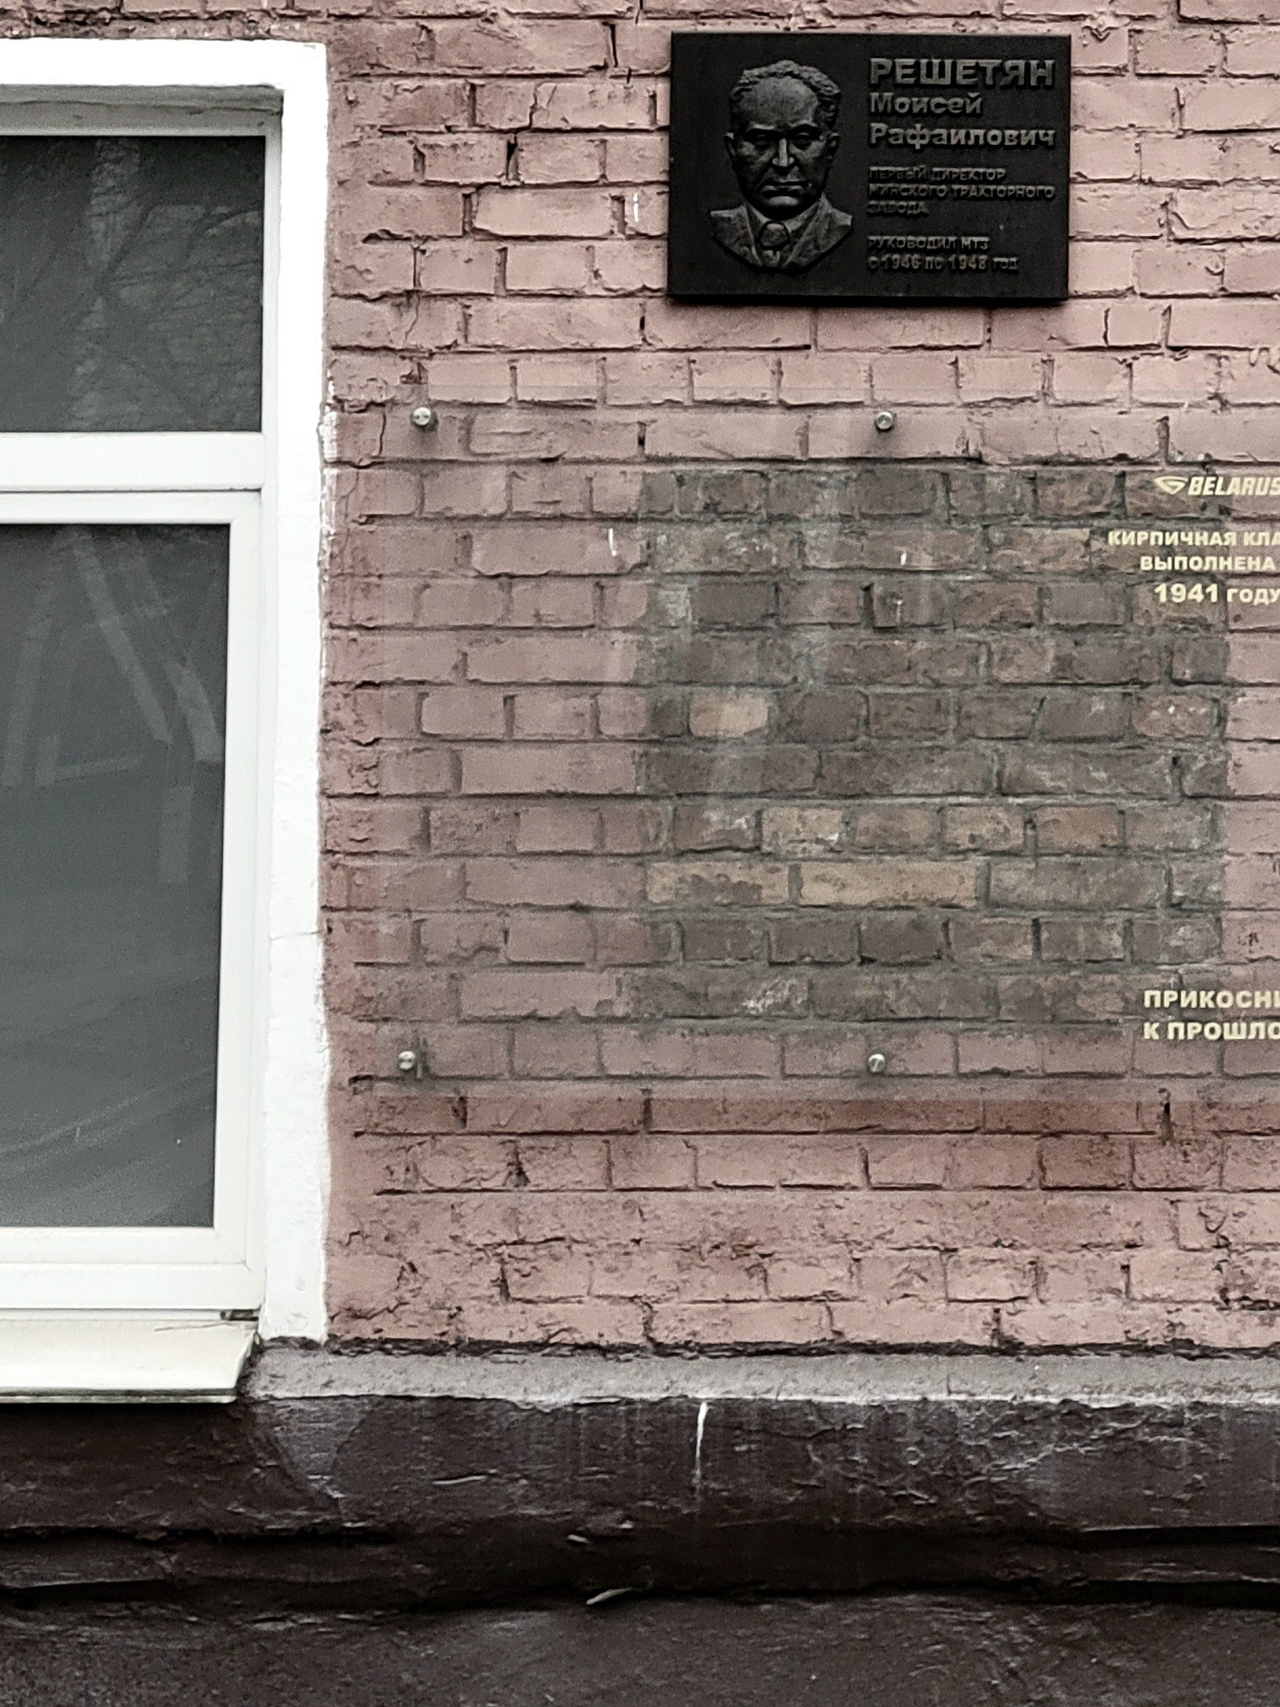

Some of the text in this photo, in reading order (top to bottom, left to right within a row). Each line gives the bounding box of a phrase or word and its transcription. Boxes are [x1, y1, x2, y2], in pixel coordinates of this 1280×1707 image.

[869, 58, 1055, 85] РЕШЕТЯН
[870, 92, 984, 114] Моисей
[870, 122, 1056, 149] Рафаилович
[869, 165, 1006, 181] ПЕРВЫЙ ДИРЕКТОР
[869, 183, 1056, 199] МИНСКОГО ТРАКТОРНОГО
[867, 200, 929, 215] ЗАВОДА
[868, 235, 990, 250] РУКОВОДИЛ МТЗ
[1108, 531, 1236, 546] КИРПИЧНАЯ
[1140, 556, 1276, 571] ВЫПОЛНЕНА
[1155, 583, 1218, 603] 1941
[1144, 1022, 1160, 1040] К
